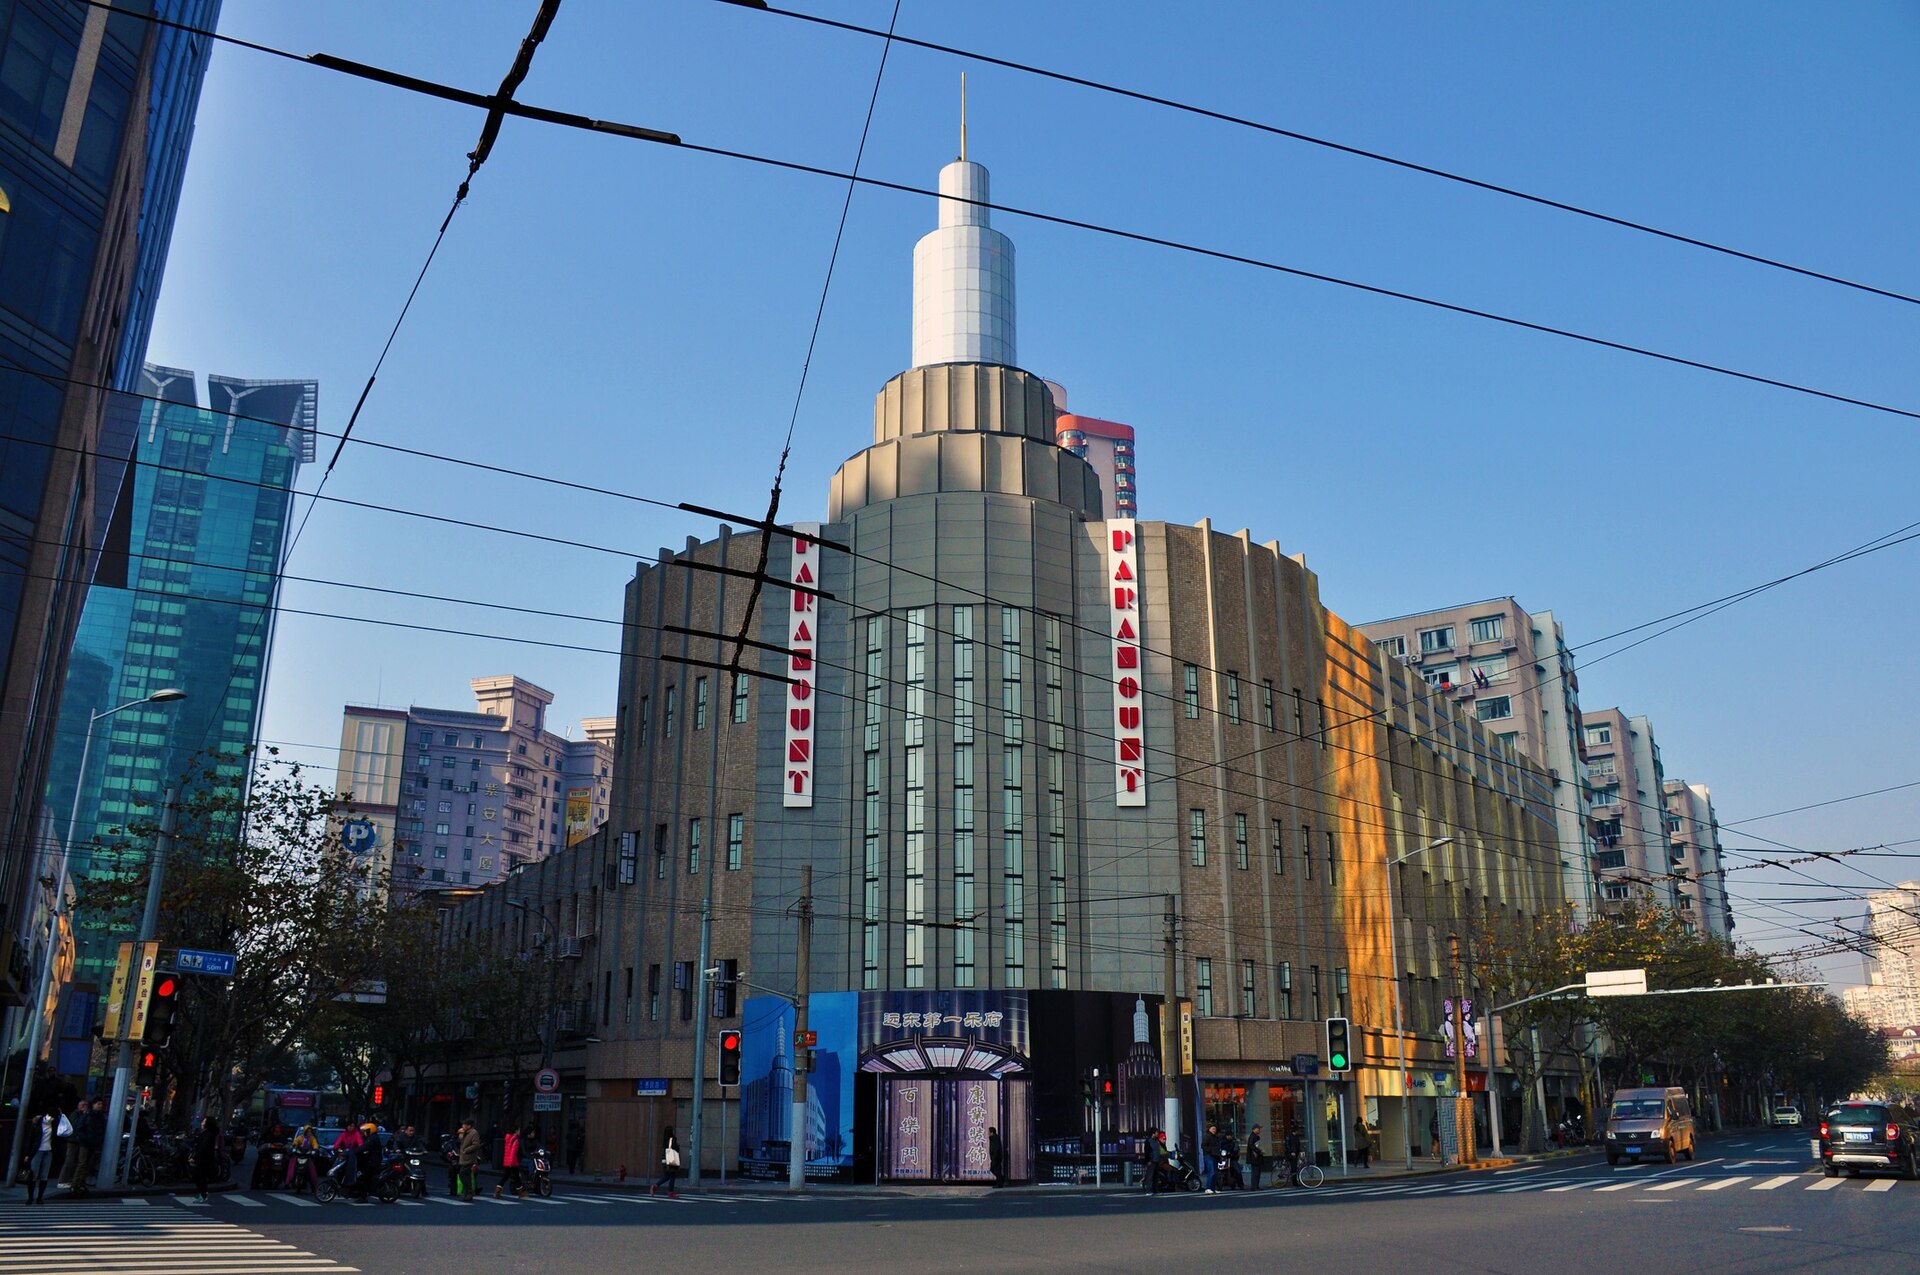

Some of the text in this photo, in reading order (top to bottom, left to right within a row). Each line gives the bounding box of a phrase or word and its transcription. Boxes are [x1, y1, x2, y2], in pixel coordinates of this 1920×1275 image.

[788, 532, 813, 793] PARAMOUNT
[1112, 530, 1142, 793] PARAMOUNT
[349, 825, 369, 847] P
[883, 1011, 1004, 1028] 远东第一乐府
[899, 1087, 920, 1166] 百樂門
